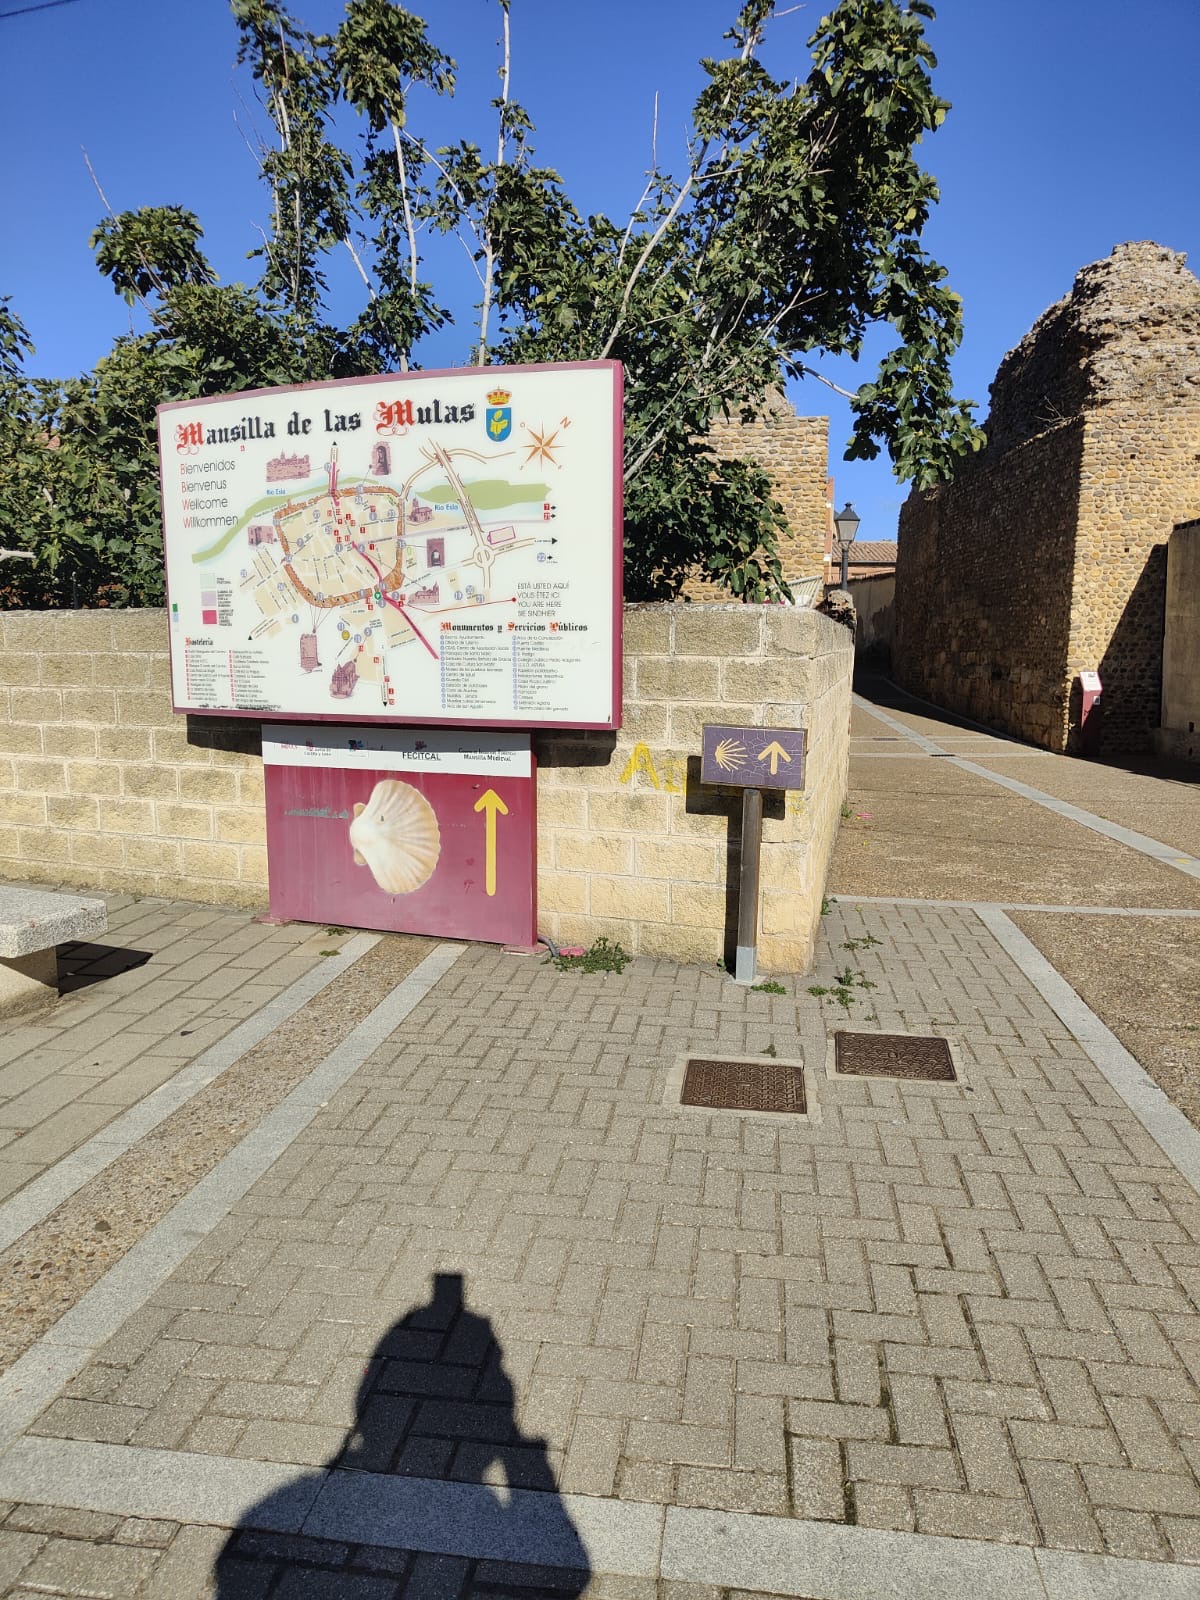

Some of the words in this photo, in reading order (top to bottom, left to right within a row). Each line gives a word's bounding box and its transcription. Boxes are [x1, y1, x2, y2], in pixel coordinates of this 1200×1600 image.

[176, 416, 276, 455] Mansilla
[287, 411, 312, 436] de
[323, 408, 361, 433] las
[373, 398, 475, 436] Mulas
[180, 460, 236, 475] Bienvenidos
[181, 479, 227, 493] Bienvenus
[183, 515, 239, 529] Willkommen
[533, 582, 552, 590] USTED
[517, 591, 535, 599] VOUS
[440, 621, 494, 632] Monumentos
[497, 625, 503, 633] y
[507, 621, 546, 632] Servicios
[549, 620, 588, 632] Públicos
[402, 752, 441, 760] FECITCAL
